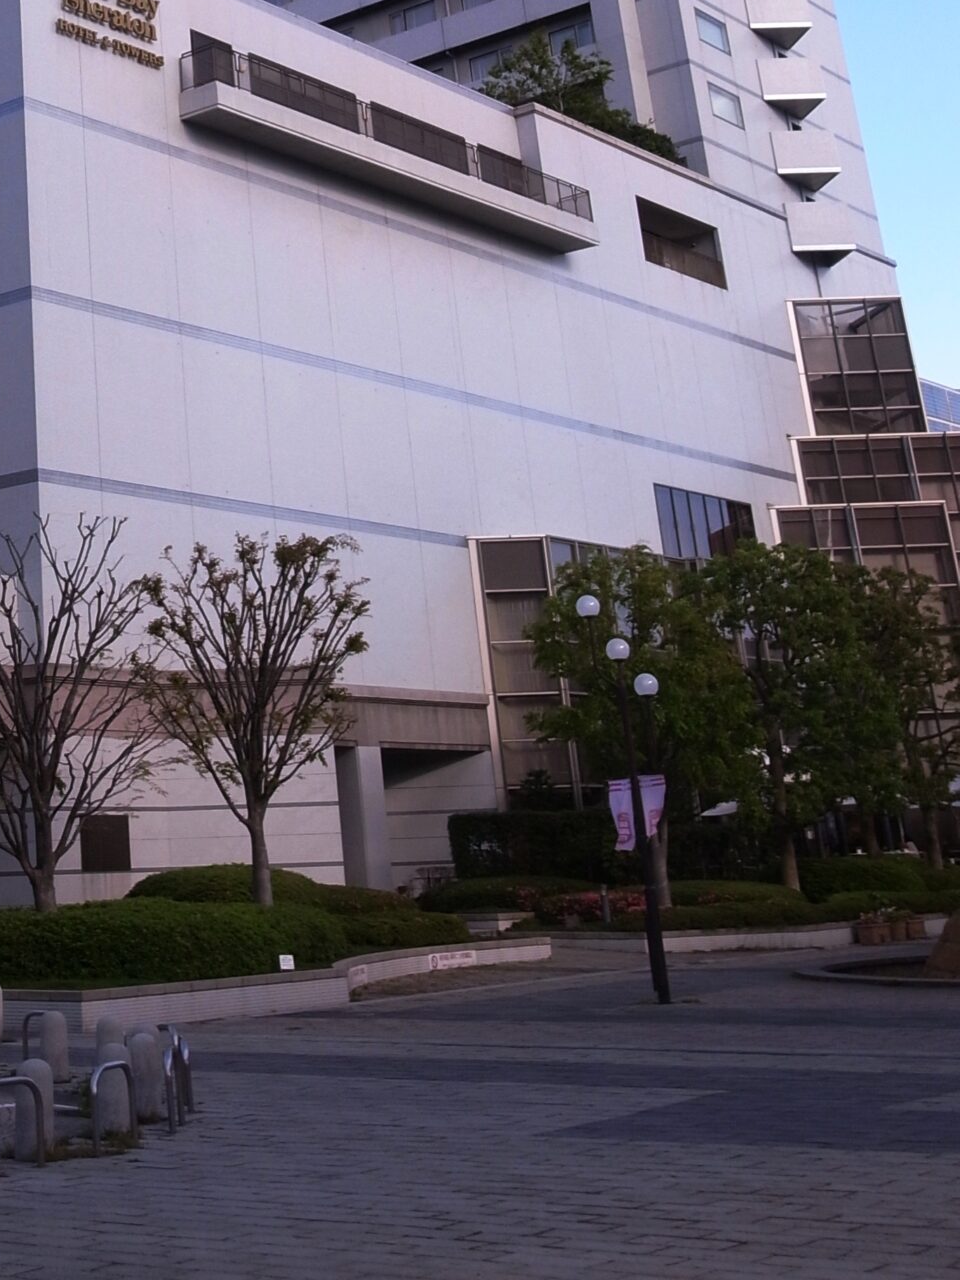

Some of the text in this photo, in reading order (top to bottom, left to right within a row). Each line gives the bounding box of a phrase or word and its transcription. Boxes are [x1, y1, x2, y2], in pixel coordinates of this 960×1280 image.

[56, 18, 165, 71] HOTEL & TOWERS
